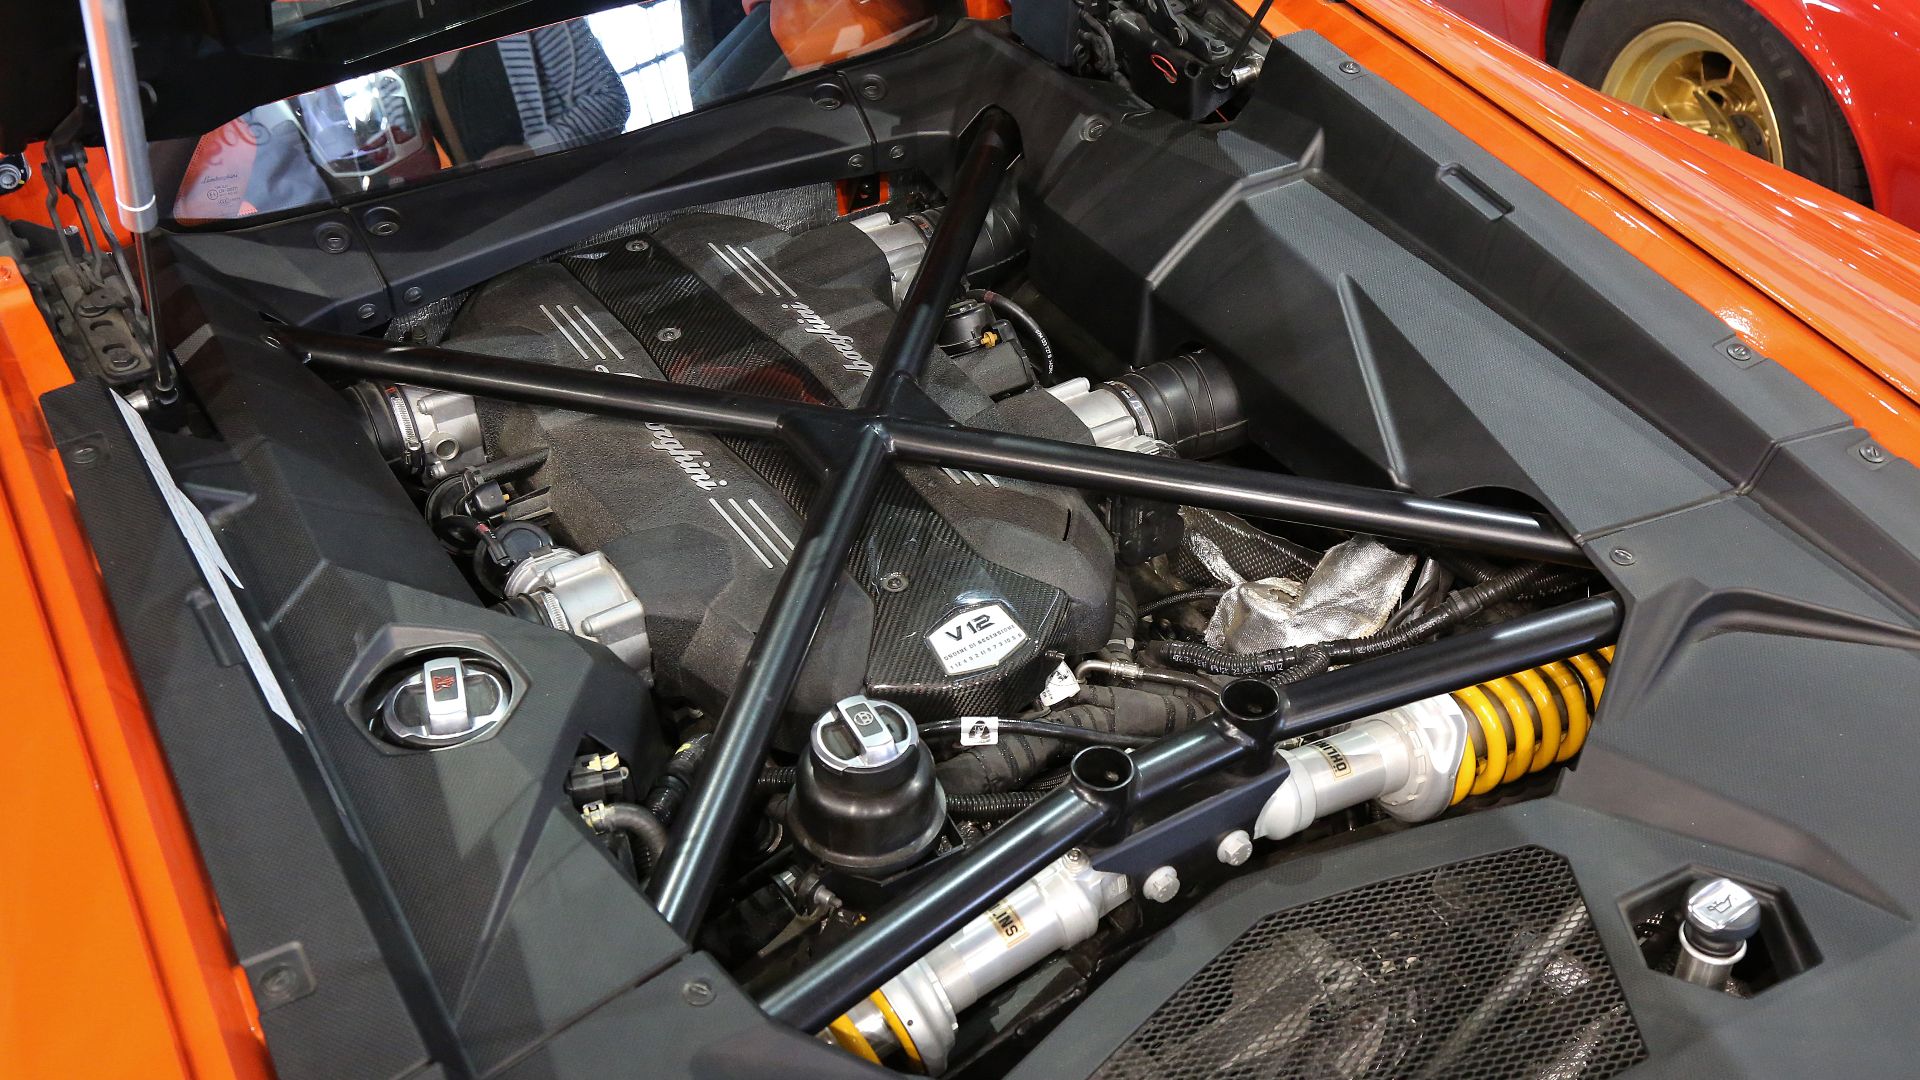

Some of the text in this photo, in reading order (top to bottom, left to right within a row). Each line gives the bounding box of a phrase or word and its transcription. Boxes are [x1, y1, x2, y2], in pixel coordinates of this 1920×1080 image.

[781, 301, 874, 379] borghini
[945, 614, 996, 642] V12
[990, 903, 1018, 937] LINS
